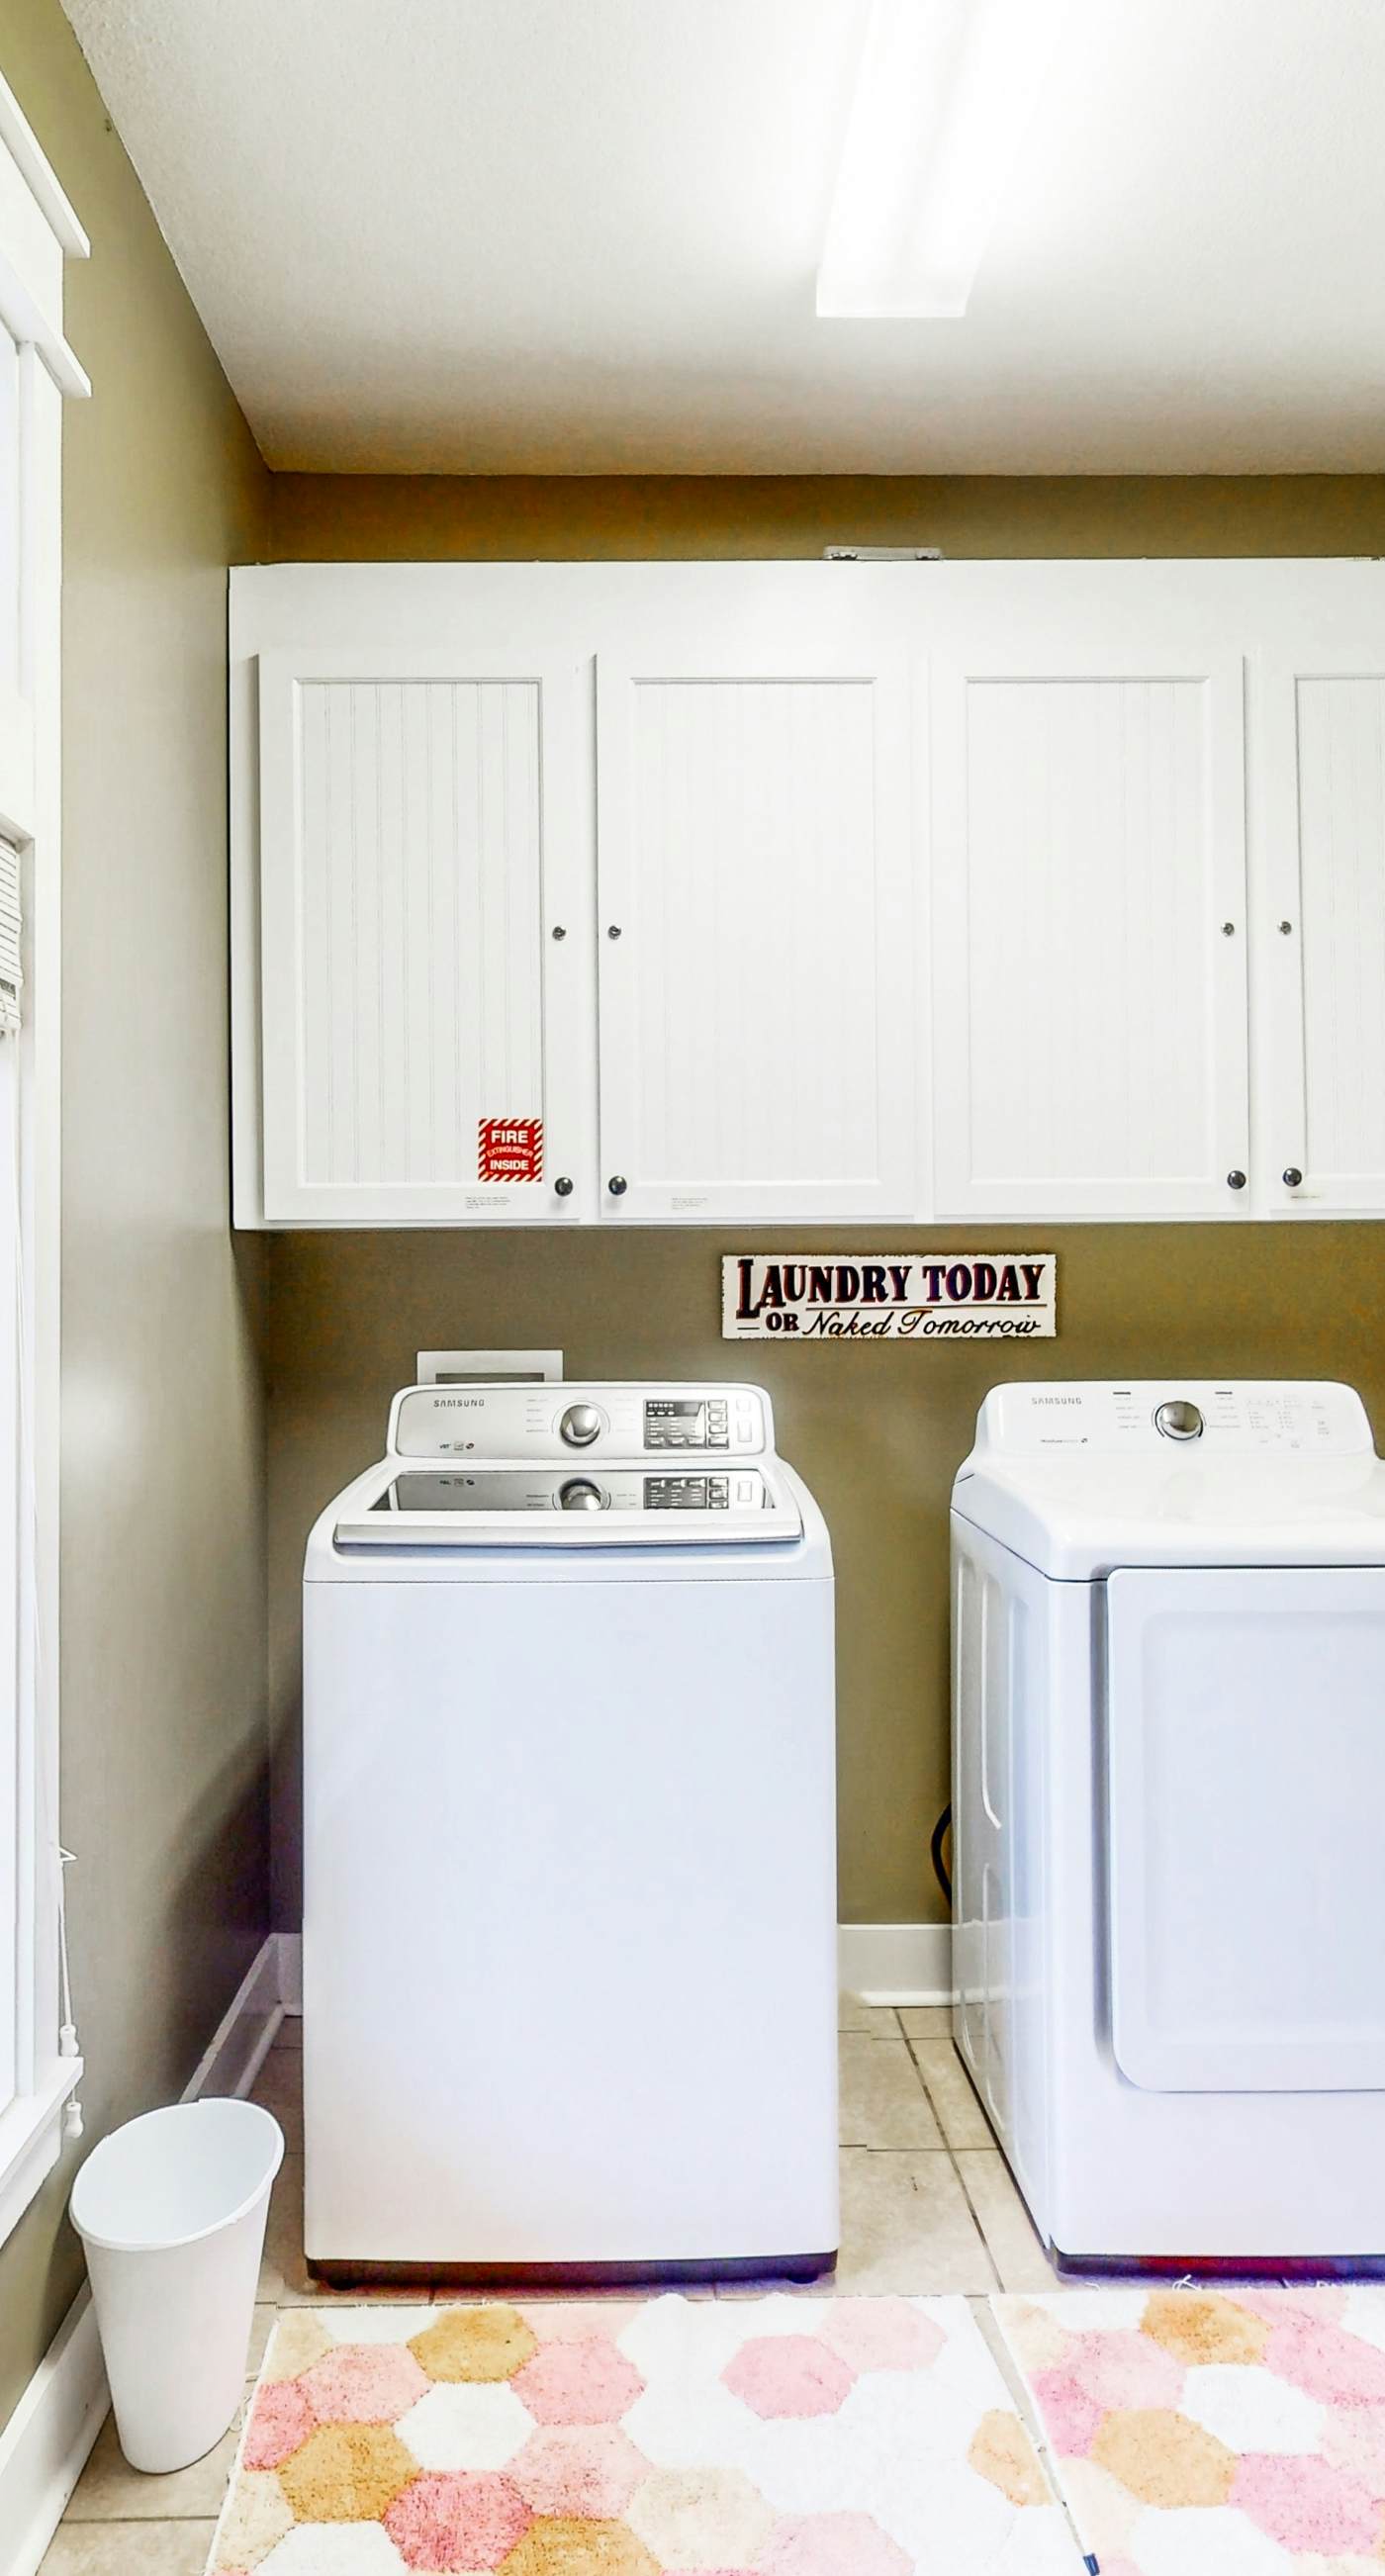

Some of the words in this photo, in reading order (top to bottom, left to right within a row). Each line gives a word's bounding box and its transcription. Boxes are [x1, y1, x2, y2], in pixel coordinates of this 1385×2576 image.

[491, 1130, 528, 1144] FIRE
[490, 1159, 529, 1170] INSIDE
[736, 1258, 912, 1319] LAUNDRY
[922, 1263, 1046, 1302] TODAY
[766, 1313, 799, 1332] OR
[802, 1311, 891, 1336] Naked
[897, 1310, 1042, 1335] Tomorrow
[433, 1399, 485, 1408] SAMSUNG
[1031, 1397, 1082, 1406] SAMSUNG
